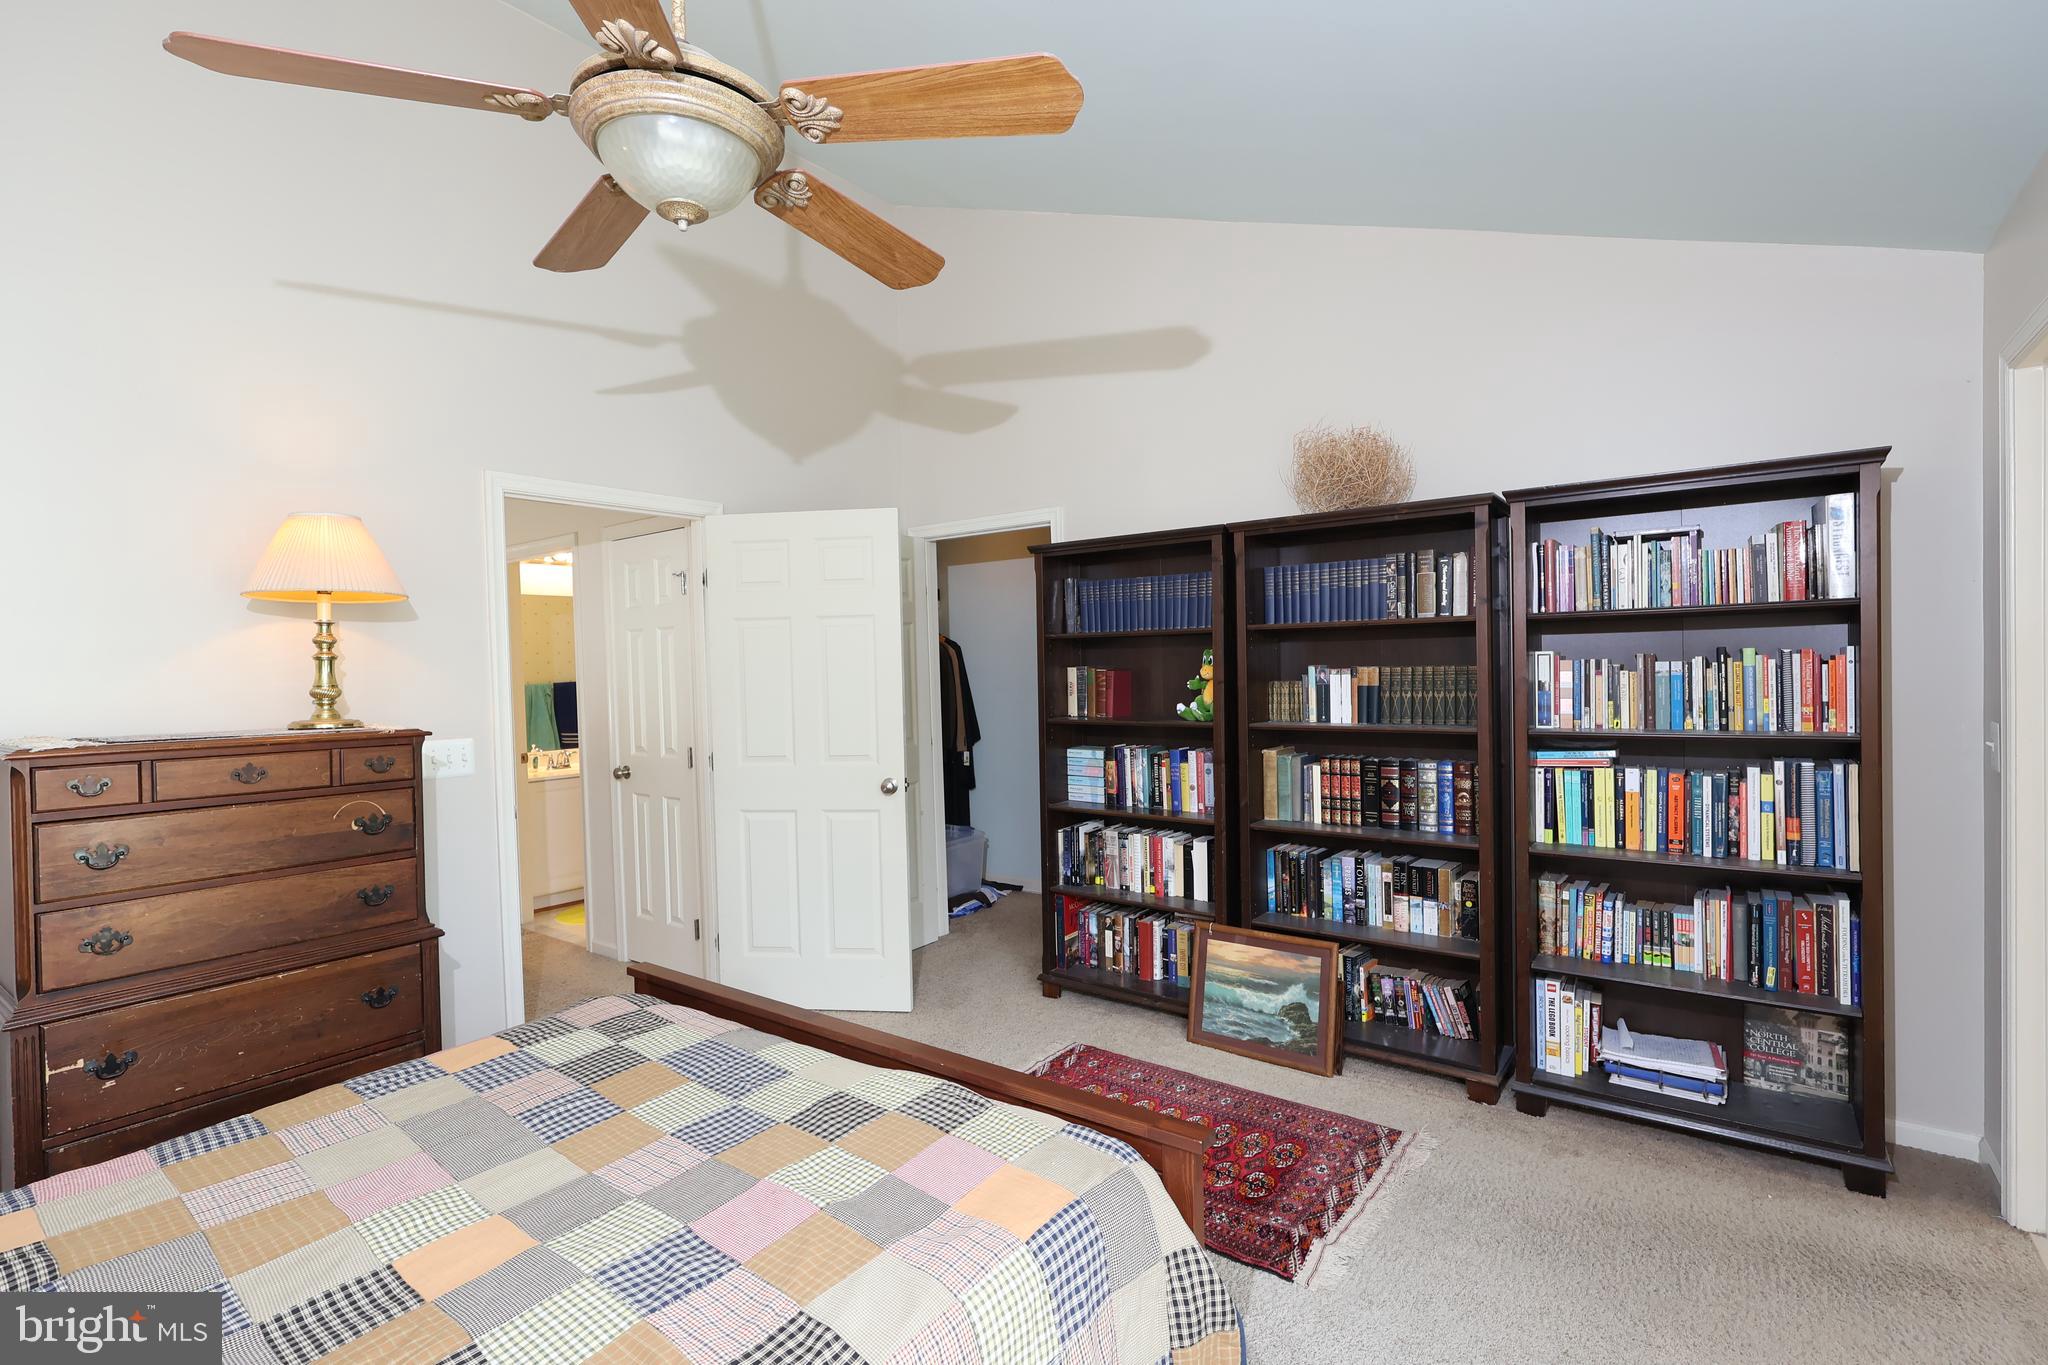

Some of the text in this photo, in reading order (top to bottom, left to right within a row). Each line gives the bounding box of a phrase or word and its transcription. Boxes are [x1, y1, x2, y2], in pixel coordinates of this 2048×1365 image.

[1693, 797, 1702, 819] TOPOLOGY
[1820, 914, 1835, 951] Mathematics
[1750, 1029, 1788, 1042] NORTH
[1750, 1036, 1799, 1051] CENTRAL
[1750, 1043, 1796, 1058] COLLEGE
